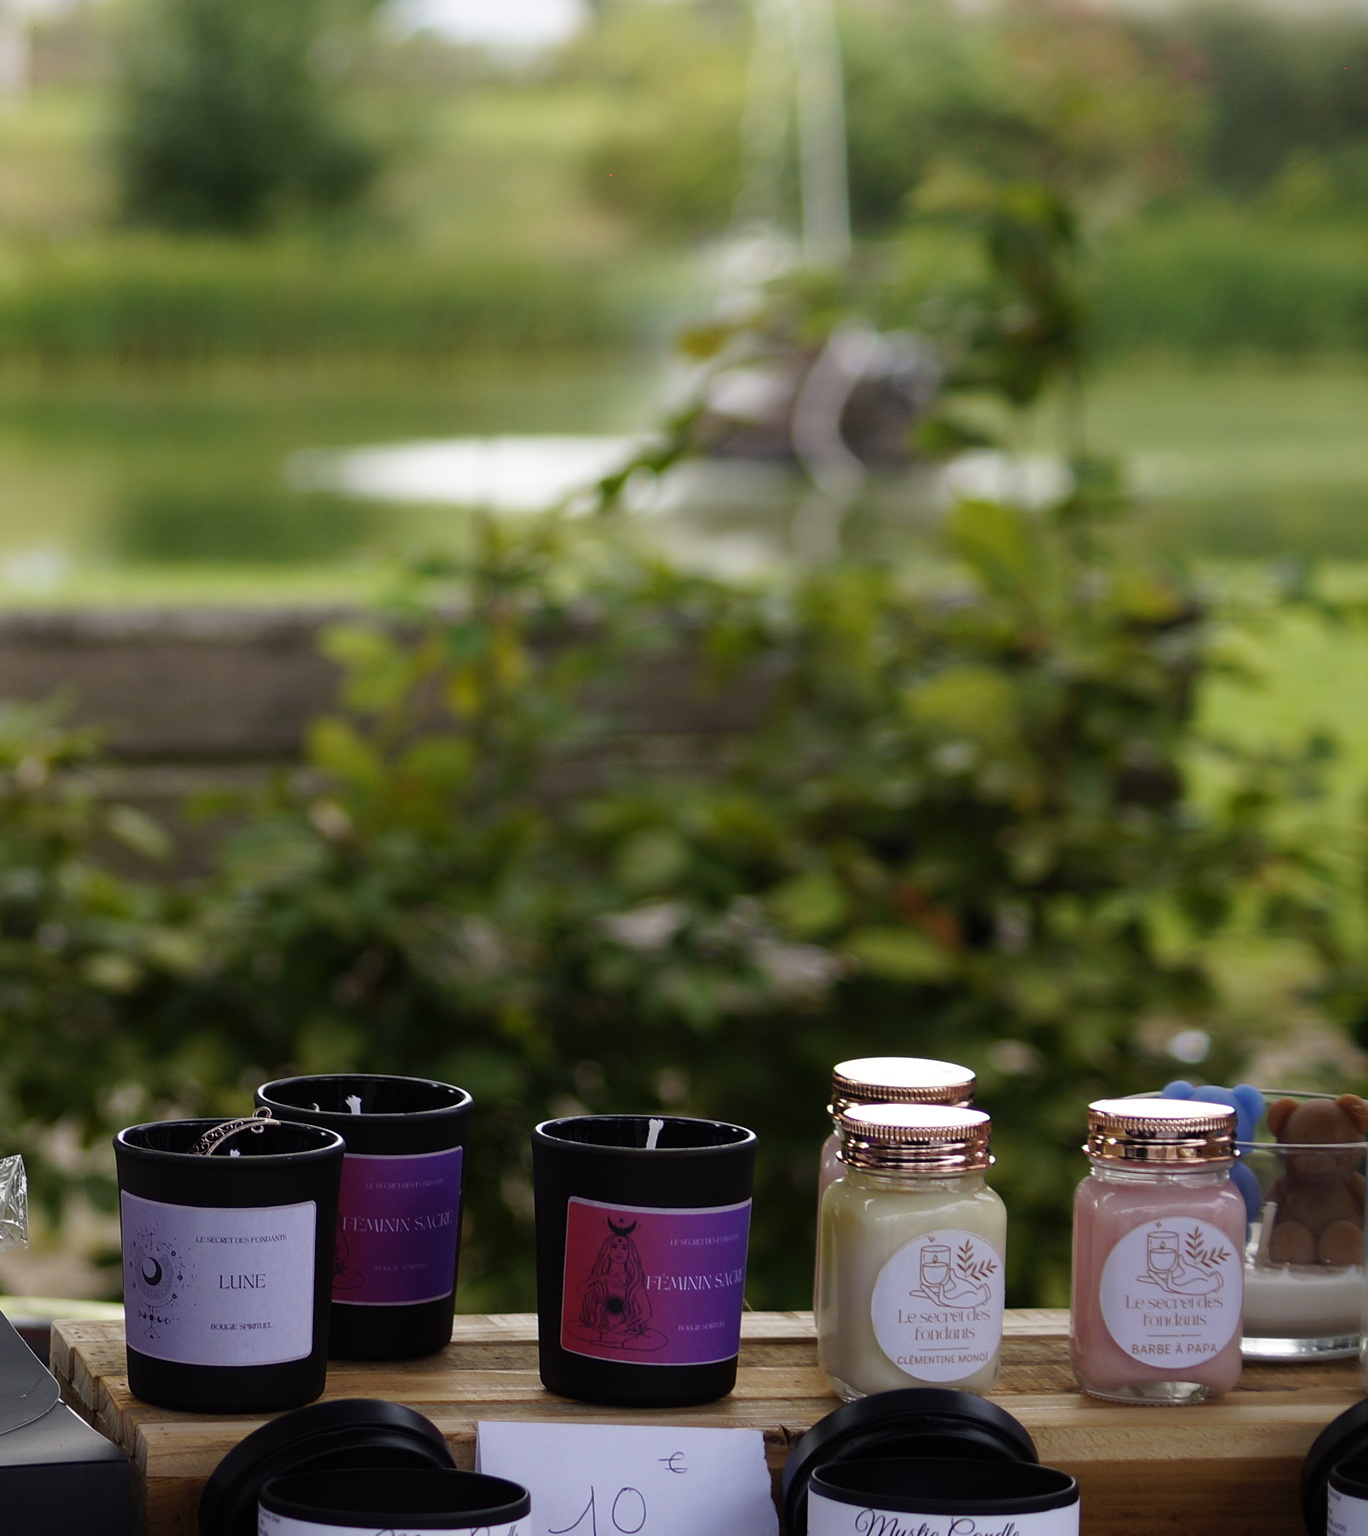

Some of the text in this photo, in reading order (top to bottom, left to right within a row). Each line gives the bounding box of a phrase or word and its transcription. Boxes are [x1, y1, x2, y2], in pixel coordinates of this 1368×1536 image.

[206, 1236, 233, 1244] SECRET
[235, 1236, 250, 1244] DES
[251, 1233, 287, 1244] FONDANTS
[219, 1273, 266, 1290] LUNE
[1125, 1294, 1224, 1309] Le secret des
[898, 1307, 991, 1323] Le secret des
[1143, 1312, 1208, 1327] fondants
[210, 1322, 238, 1331] BOUGIE
[915, 1326, 976, 1341] fondants
[1132, 1341, 1218, 1355] BARBE À PAPA
[897, 1351, 989, 1365] CLÉMENTINE MONOÏ
[657, 1451, 689, 1474] €
[548, 1486, 647, 1536] 10
